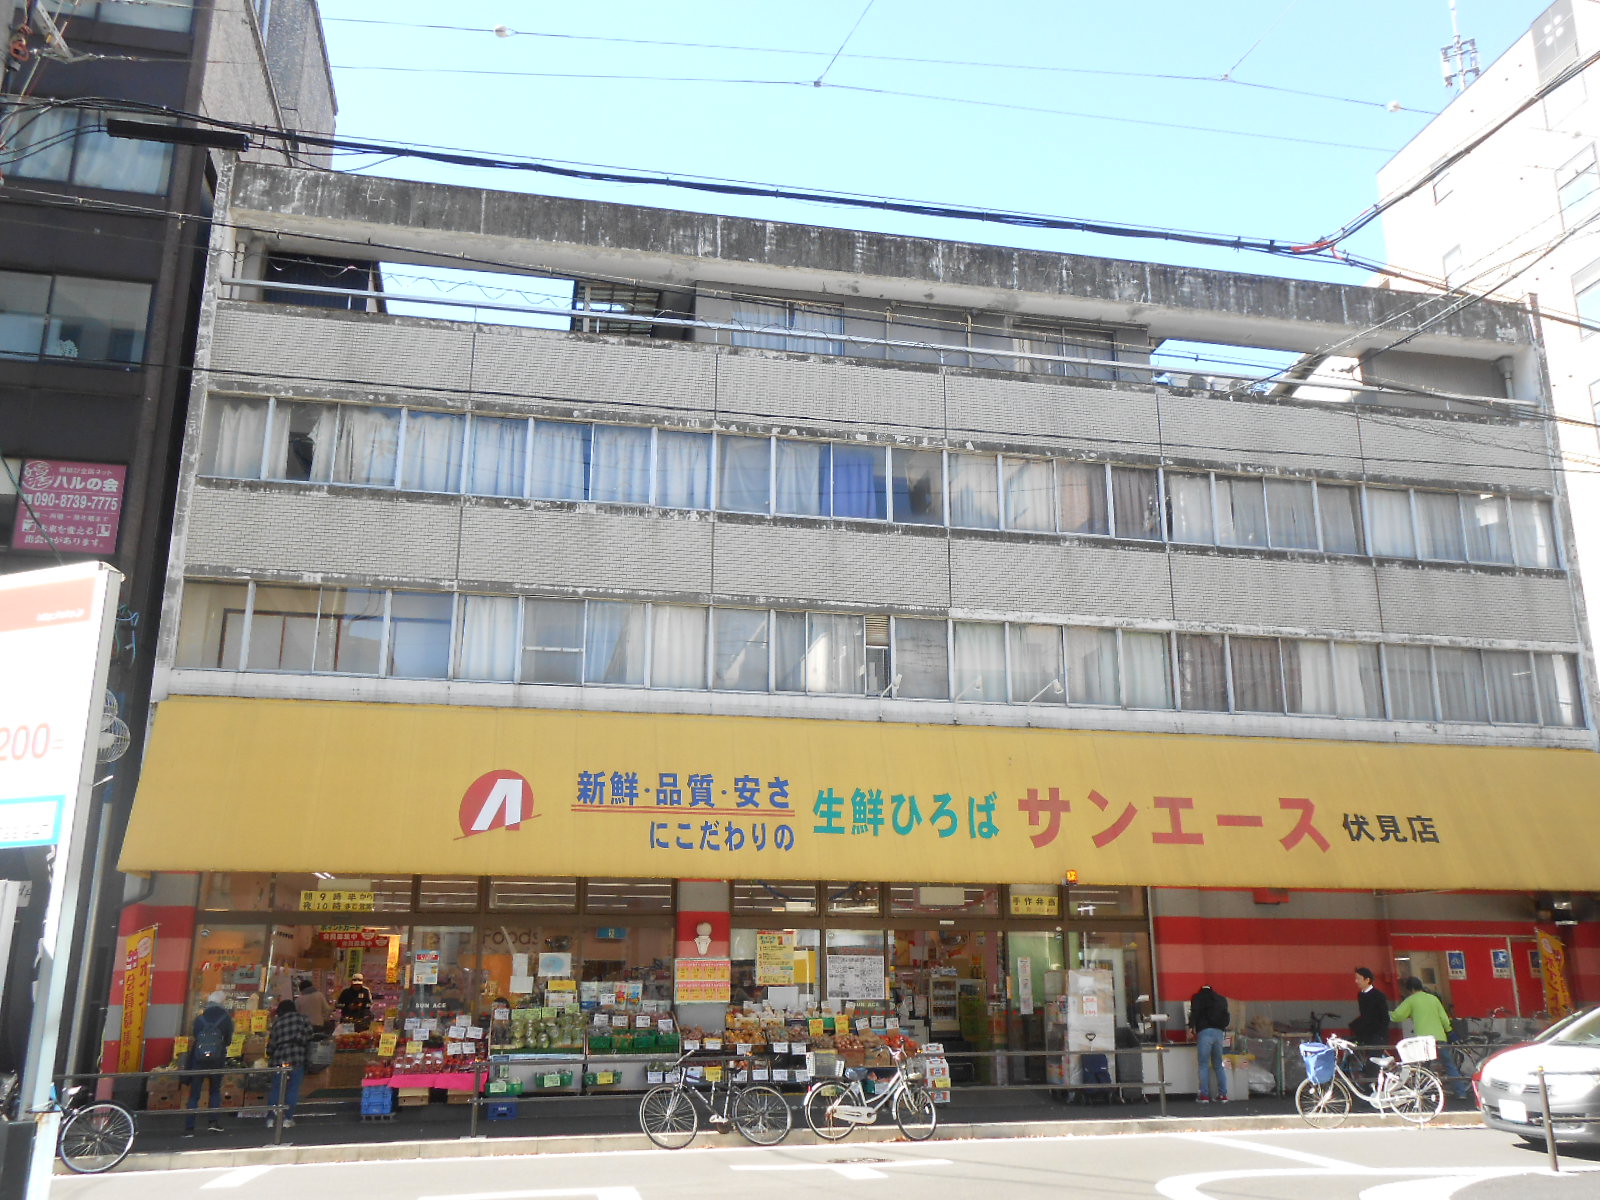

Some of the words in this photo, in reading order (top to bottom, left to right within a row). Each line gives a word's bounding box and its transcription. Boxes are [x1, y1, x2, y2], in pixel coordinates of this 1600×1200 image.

[52, 475, 119, 492] ハルの会
[34, 492, 118, 511] 090-8739-7775
[812, 787, 1000, 839] 生鮮ひろば
[1017, 786, 1331, 854] サンエース
[1342, 813, 1442, 845] 伏見店
[649, 820, 796, 851] にこだわりの
